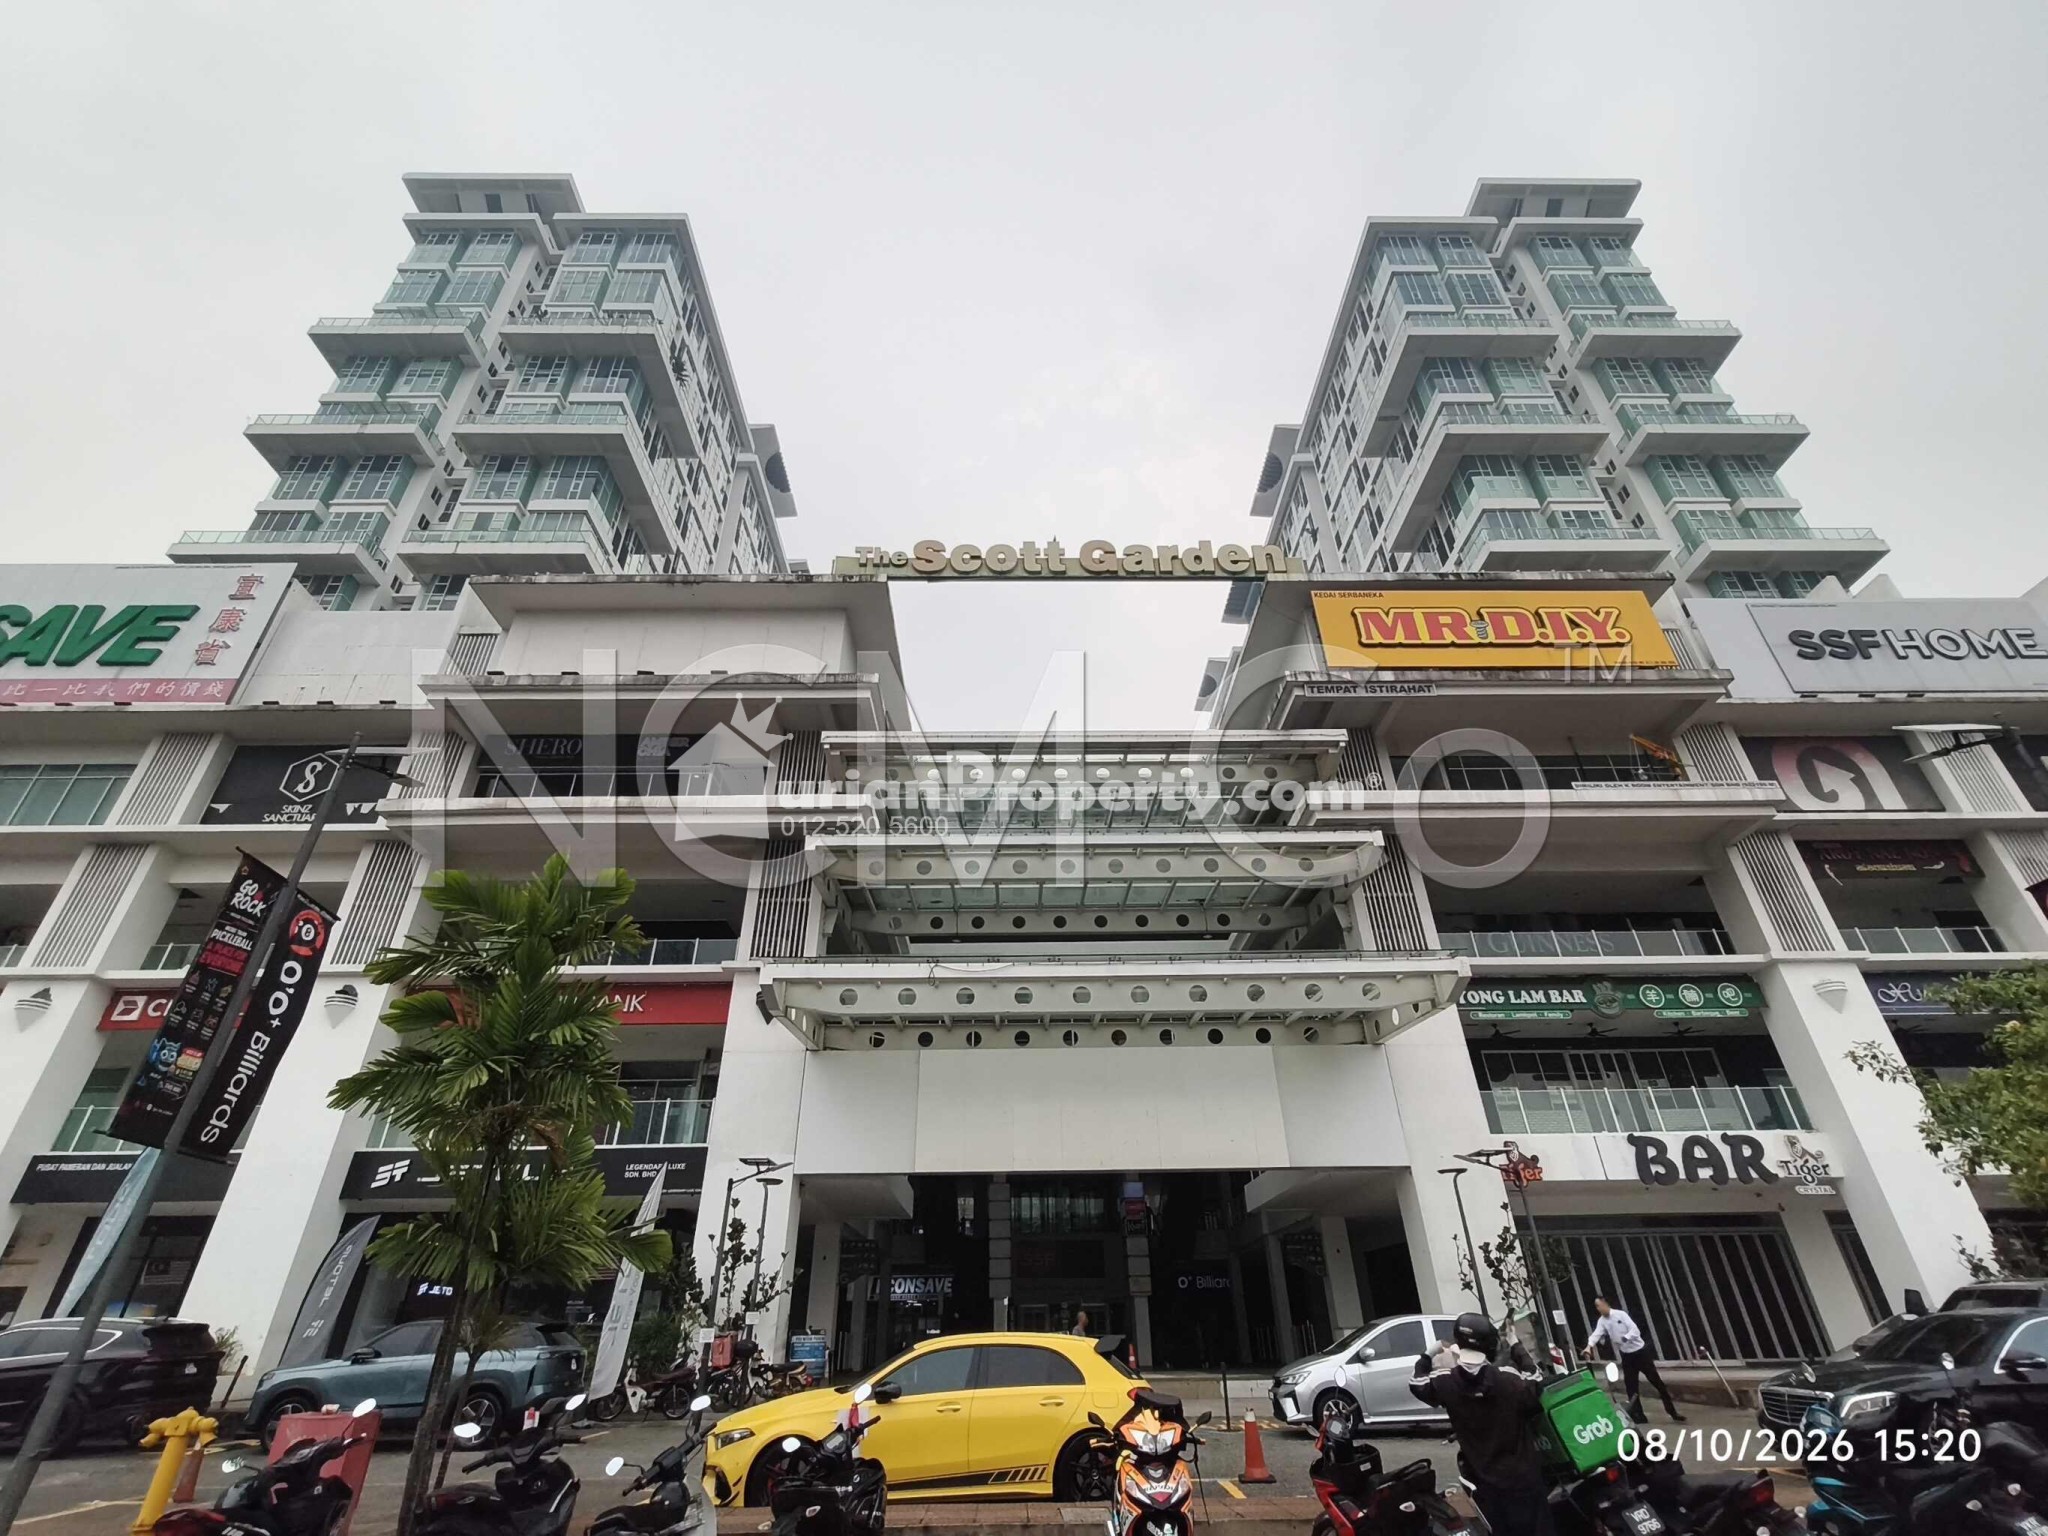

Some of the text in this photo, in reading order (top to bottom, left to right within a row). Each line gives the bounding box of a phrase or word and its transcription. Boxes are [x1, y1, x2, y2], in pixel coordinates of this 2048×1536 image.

[855, 539, 1288, 575] The Scott Garden
[195, 573, 265, 667] 宜康省
[1308, 684, 1433, 694] TEMPAT ISTIRAHAT
[504, 737, 583, 756] SHERO
[281, 804, 313, 813] SKINZ
[239, 879, 259, 897] GO
[230, 892, 267, 918] ROCK
[210, 928, 253, 951] PICKLEBALL
[1487, 932, 1615, 954] GUINNESS
[1507, 990, 1547, 1004] LAM
[1547, 989, 1587, 1003] BAR
[201, 1030, 269, 1145] Billiards
[625, 1163, 664, 1171] LEGENDAR
[1627, 1131, 1779, 1187] BAR
[1778, 1159, 1832, 1186] Tiger
[1797, 1186, 1836, 1195] CRYSTAL
[1573, 1414, 1614, 1445] Grab
